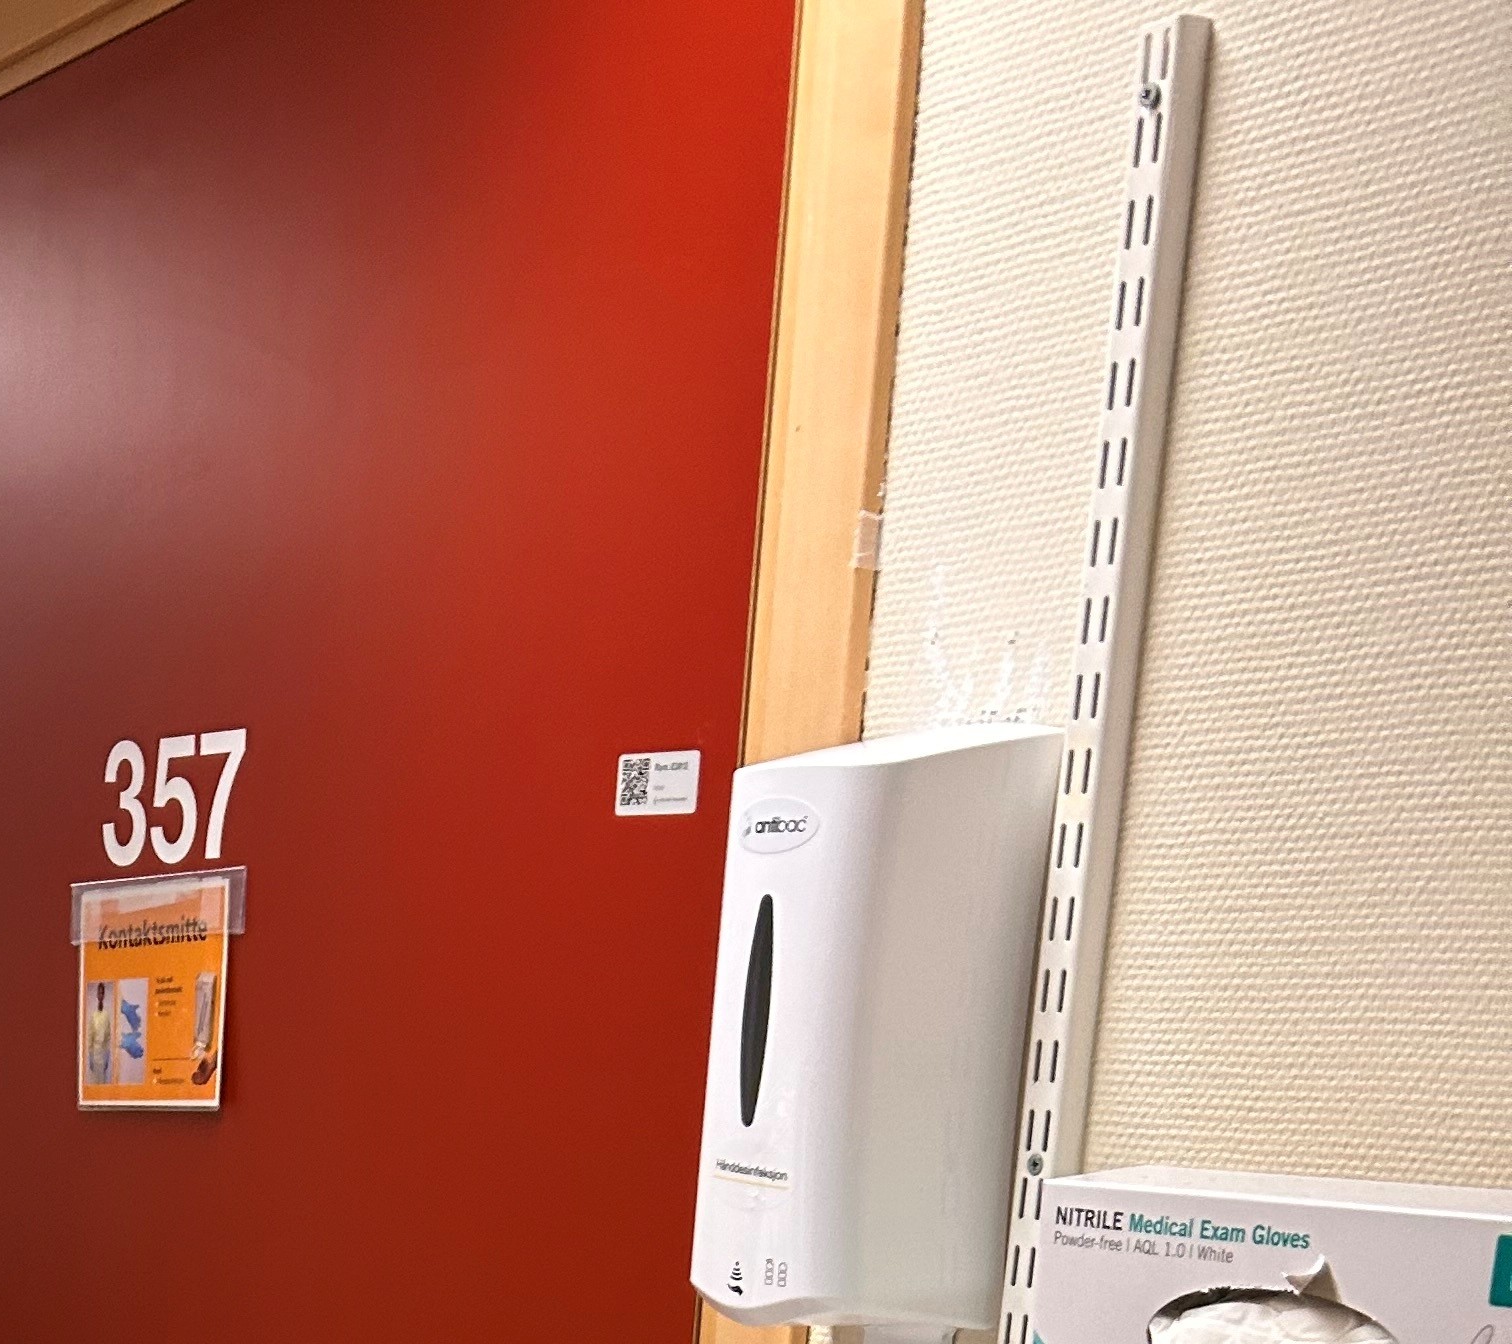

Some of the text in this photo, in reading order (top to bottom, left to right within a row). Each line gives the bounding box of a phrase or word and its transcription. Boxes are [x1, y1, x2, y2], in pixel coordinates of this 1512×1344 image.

[102, 728, 247, 868] 357
[1054, 1231, 1123, 1252] Powder-free
[1132, 1239, 1159, 1256] AQL
[1164, 1241, 1185, 1258] 1.0
[1197, 1245, 1234, 1263] White
[1055, 1206, 1310, 1249] NITRILE Medical Exam Gloves
